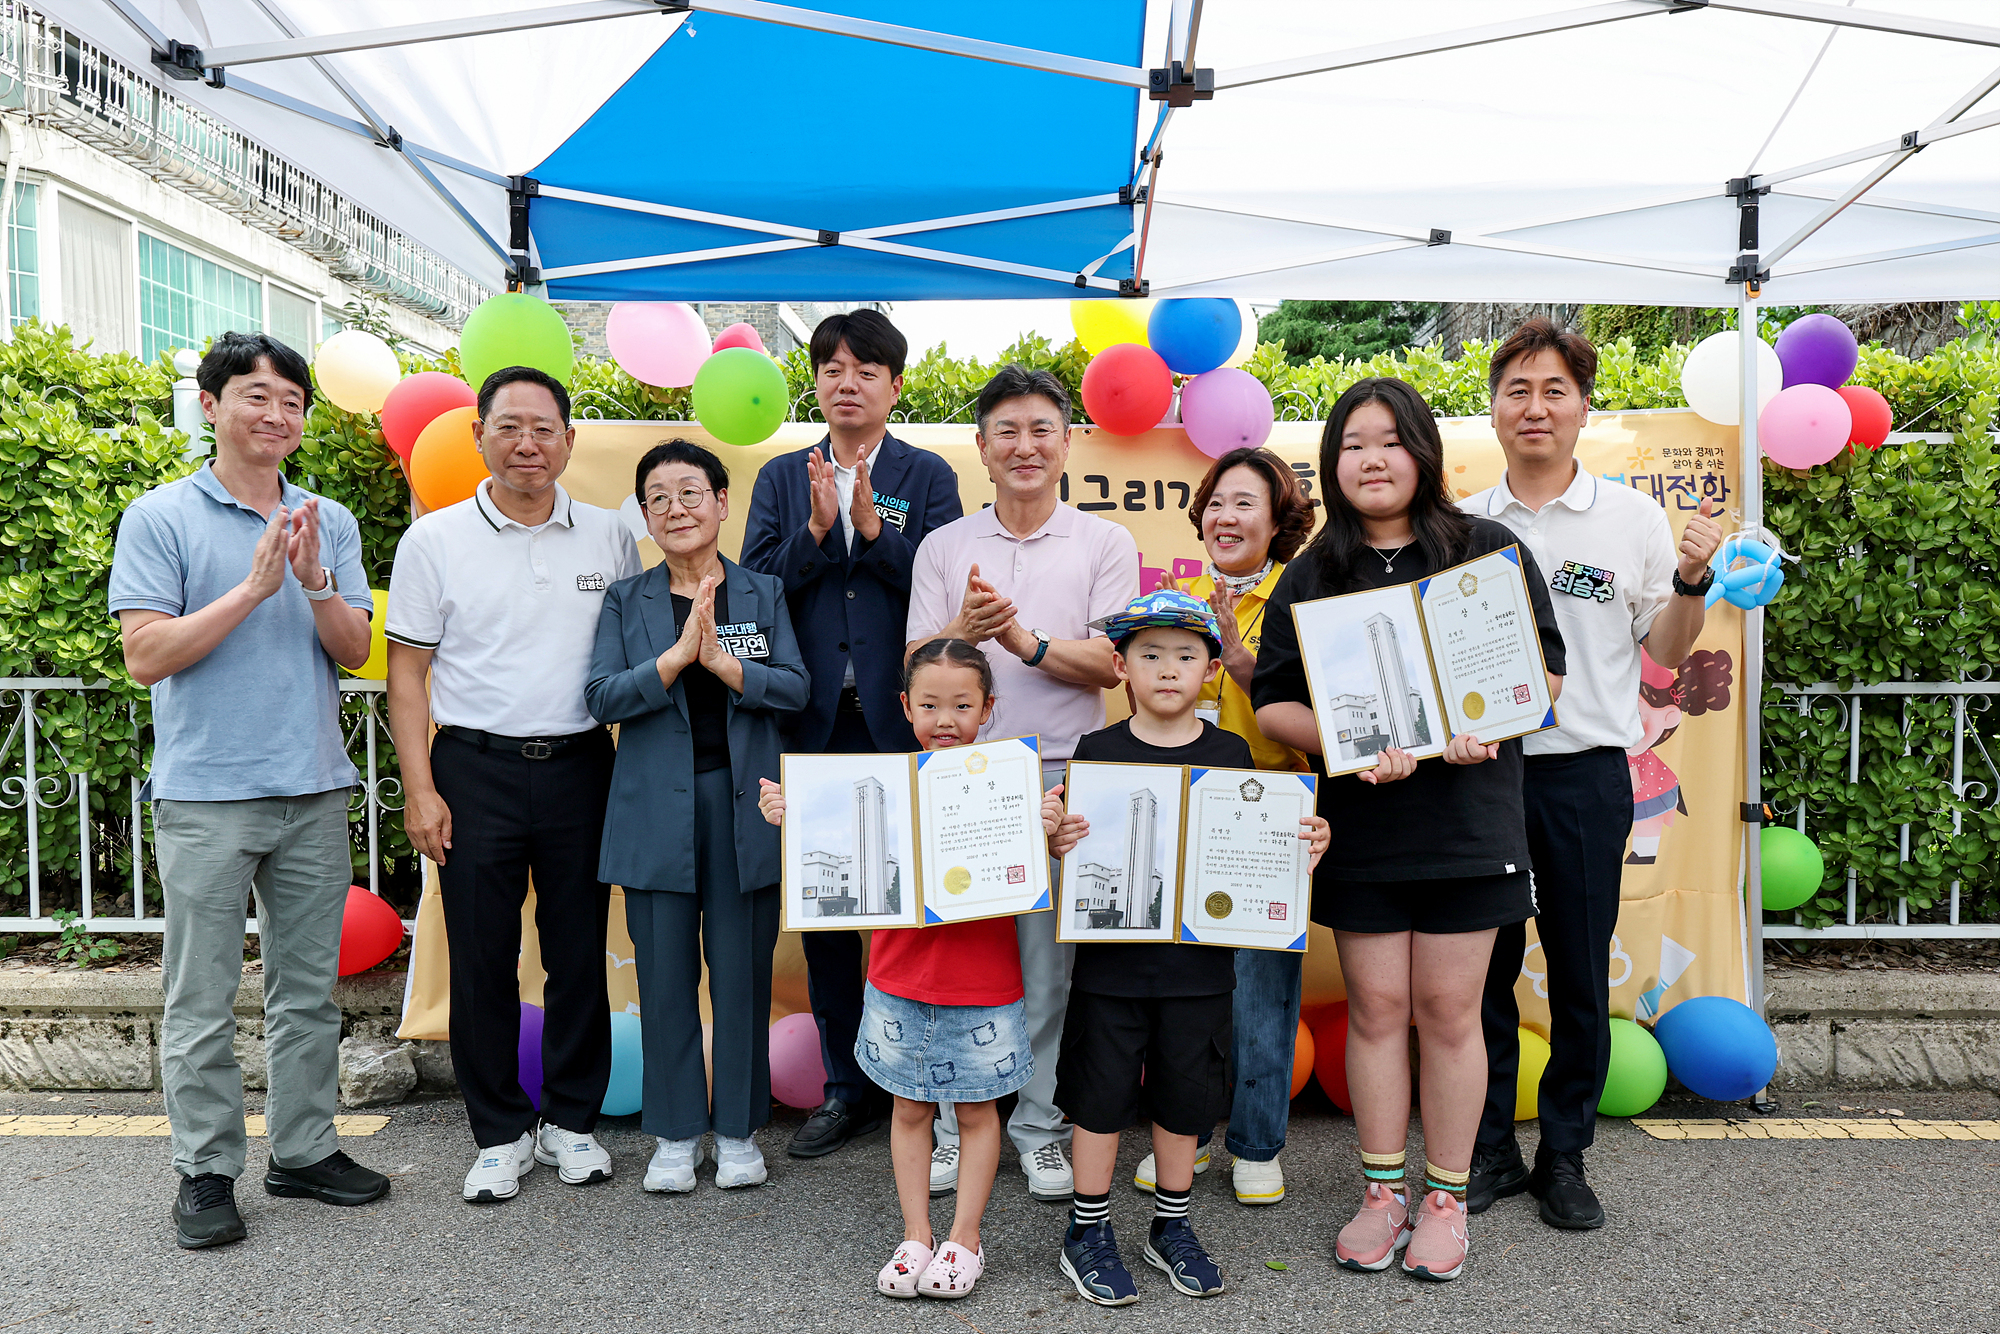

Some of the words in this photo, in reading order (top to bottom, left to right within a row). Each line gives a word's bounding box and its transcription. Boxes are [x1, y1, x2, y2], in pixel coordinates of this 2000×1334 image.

[1662, 447, 1693, 458] 문화와
[1695, 446, 1724, 457] 경제가
[1672, 459, 1692, 469] 살아
[1694, 459, 1704, 470] 숨
[1707, 458, 1725, 470] 쉬는
[1602, 471, 1731, 518] 대전환
[1563, 561, 1614, 583] 도봉구의원
[1551, 571, 1614, 602] 최승수
[1461, 608, 1468, 618] 상
[1482, 601, 1489, 611] 장
[962, 785, 970, 795] 상
[988, 781, 996, 791] 장
[1234, 811, 1243, 821] 상
[1260, 813, 1269, 823] 장
